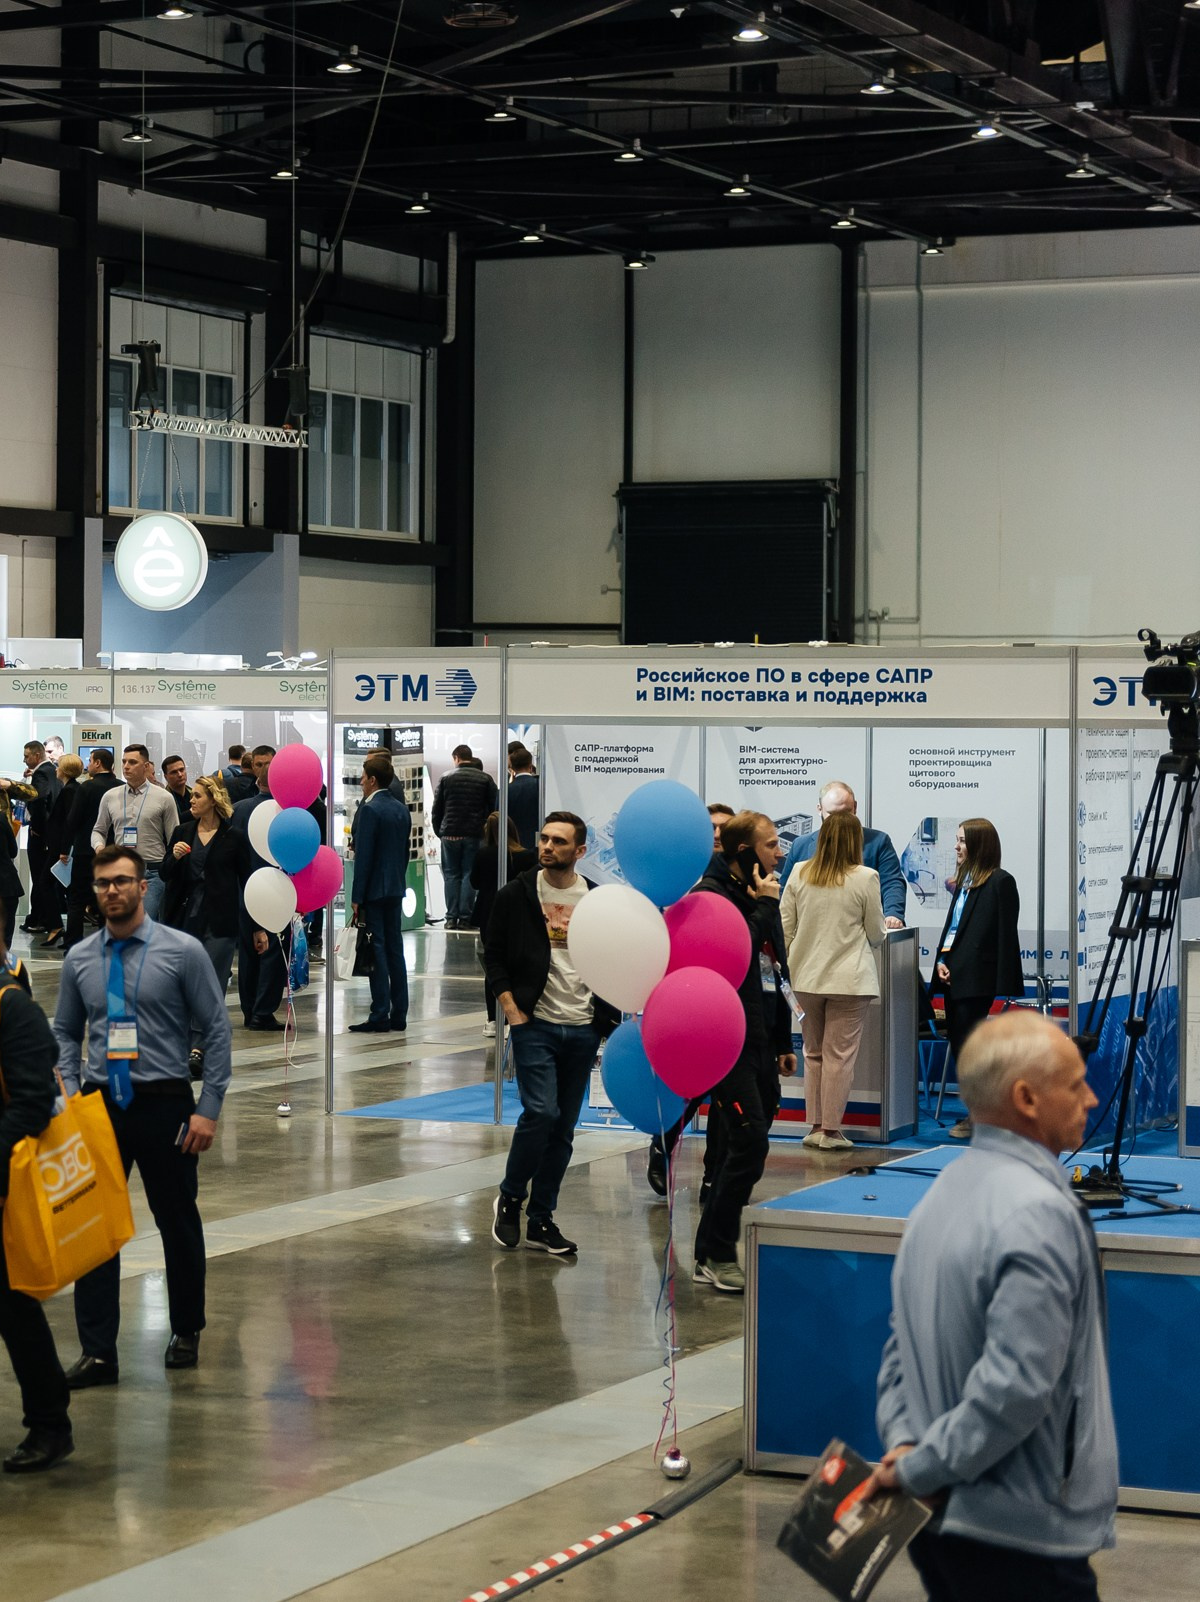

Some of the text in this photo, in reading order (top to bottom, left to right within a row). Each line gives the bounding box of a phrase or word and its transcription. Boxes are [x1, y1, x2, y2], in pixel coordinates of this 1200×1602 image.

[636, 667, 933, 687] Российское ПО в сфере САПР
[12, 680, 68, 692] Systême
[121, 685, 155, 693] 136.137
[158, 680, 216, 693] Systême
[280, 680, 327, 694] Systêm
[355, 674, 428, 702] ЭТМ
[30, 690, 68, 699] electric
[176, 691, 216, 700] electric
[299, 691, 326, 701] elect
[636, 687, 927, 706] и BIM: поставка и поддержка
[1093, 676, 1157, 707] ЭТ
[82, 731, 112, 740] DEKraft
[574, 744, 654, 755] САПР-платформа
[909, 748, 1016, 758] основной инструмент
[582, 755, 639, 764] поддержкой
[739, 757, 827, 766] для архитектурно-
[909, 759, 992, 768] проектировщика
[593, 766, 665, 775] моделирования
[739, 767, 808, 777] строительного
[909, 770, 955, 778] щитового
[739, 778, 816, 788] проектирования
[909, 780, 979, 789] оборудования
